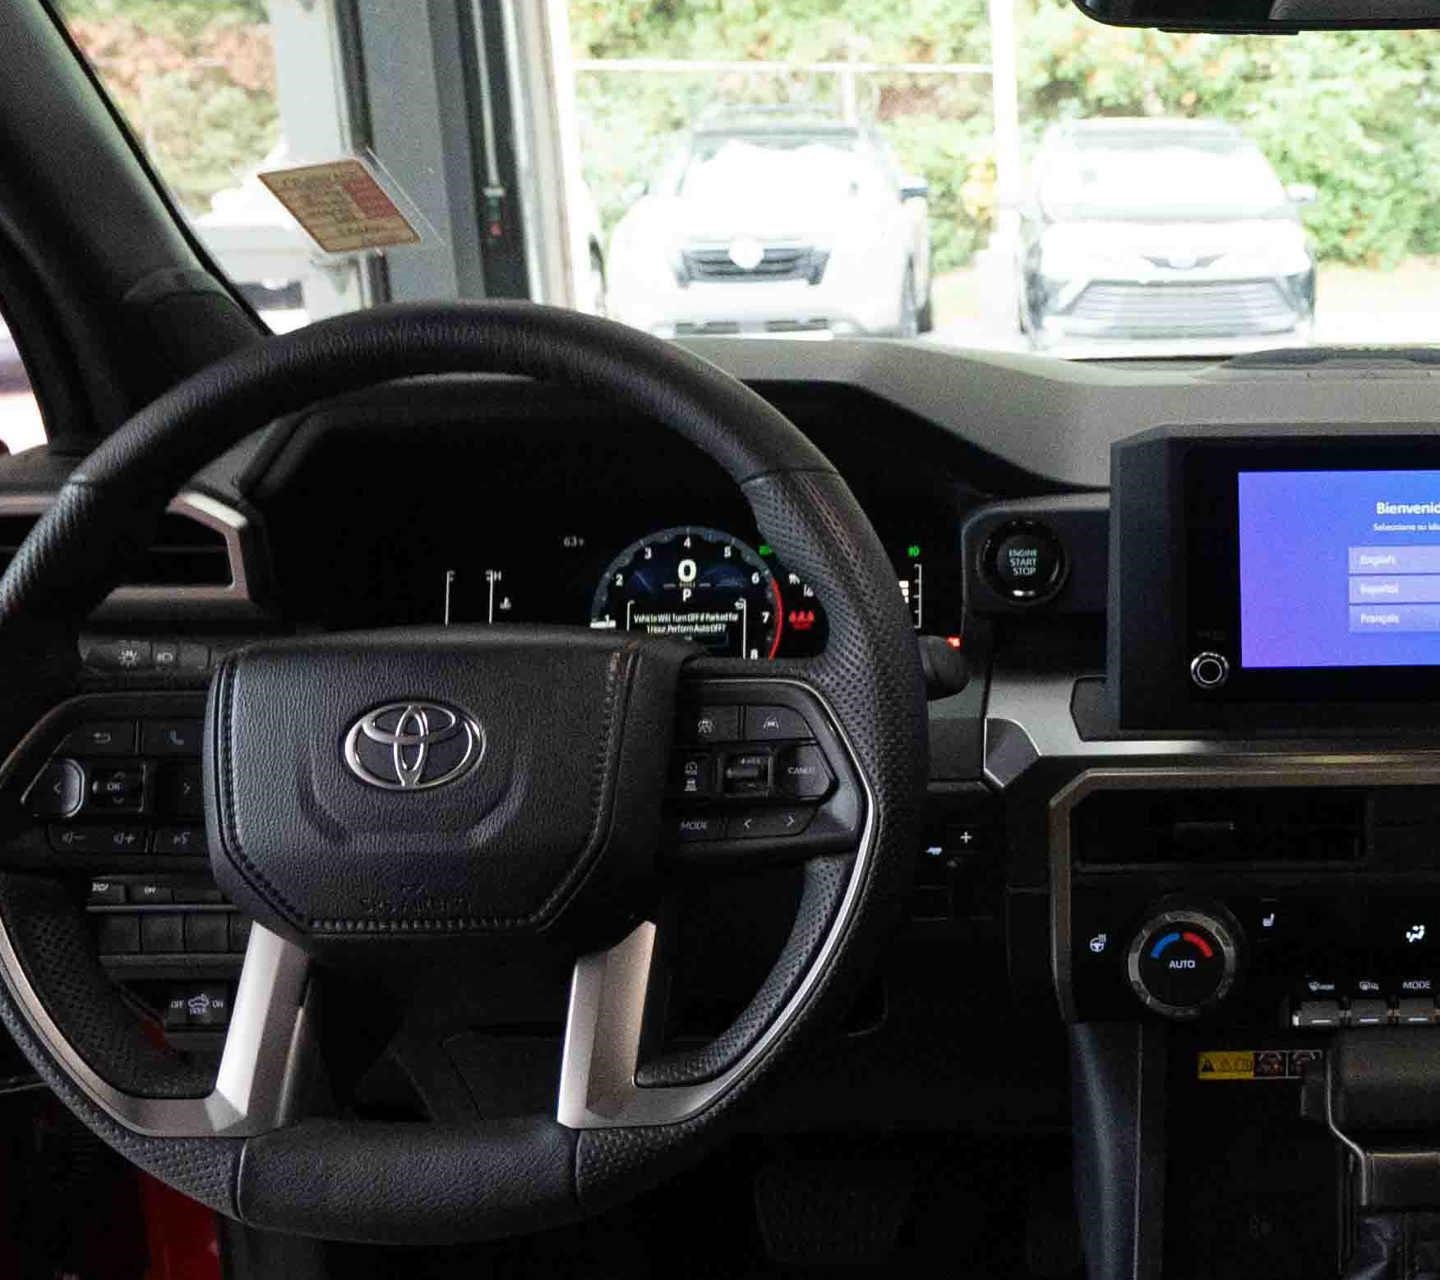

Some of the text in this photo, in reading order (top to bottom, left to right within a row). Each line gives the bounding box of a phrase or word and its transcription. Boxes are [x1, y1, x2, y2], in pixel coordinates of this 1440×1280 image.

[683, 537, 692, 549] 4
[643, 547, 652, 559] 3
[724, 547, 731, 558] 5
[1010, 558, 1037, 567] START
[677, 559, 697, 582] 0
[1013, 567, 1037, 576] STOP
[615, 574, 624, 586] 2
[751, 573, 760, 584] 6
[682, 589, 692, 602] P
[672, 612, 687, 622] Turn
[762, 612, 770, 624] 7
[1168, 959, 1196, 969] AUTO
[1402, 980, 1431, 990] MODE
